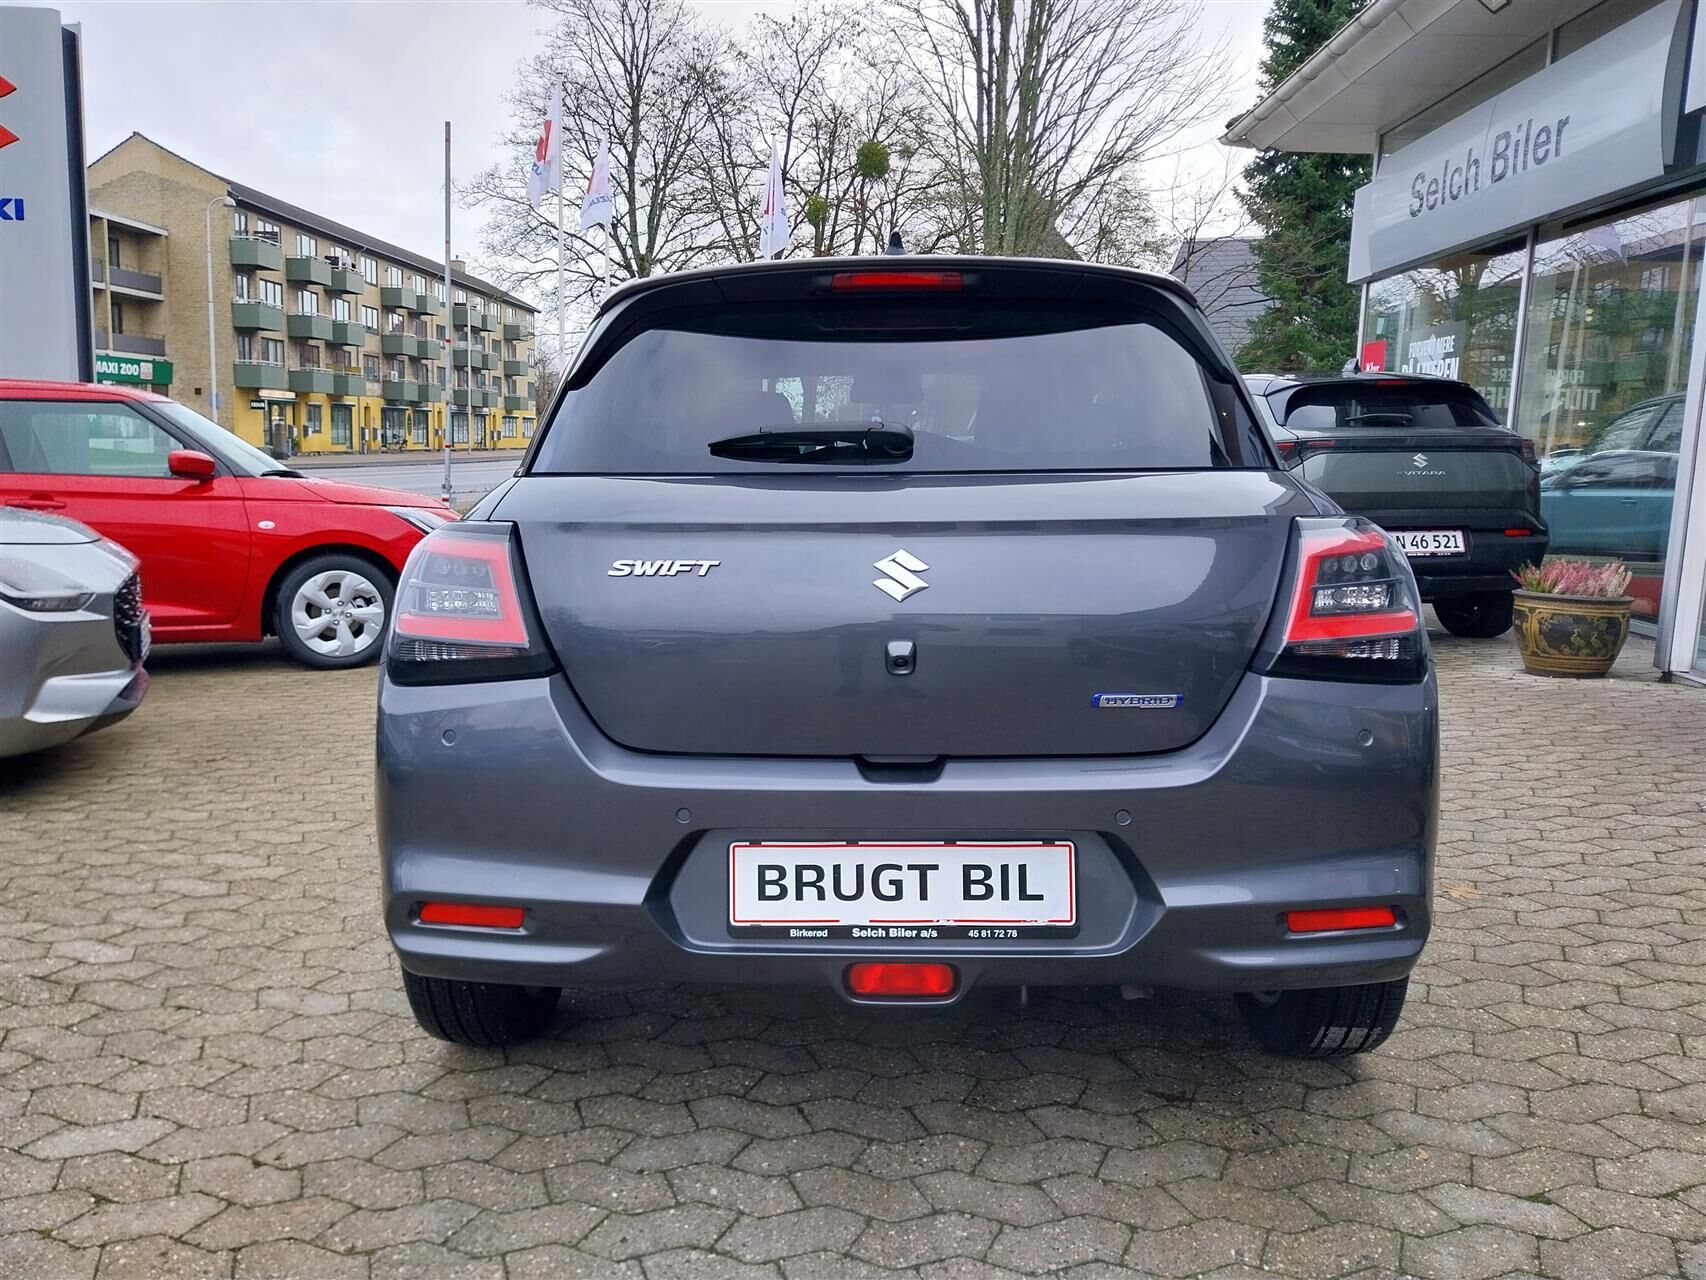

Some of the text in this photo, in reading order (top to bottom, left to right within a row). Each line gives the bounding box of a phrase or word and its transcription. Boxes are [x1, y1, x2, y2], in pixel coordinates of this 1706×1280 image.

[1409, 115, 1570, 218] Selch Biler
[120, 363, 140, 376] ZOO
[1410, 534, 1429, 549] 46
[1433, 534, 1460, 549] 521
[607, 559, 721, 578] SWIFT
[1103, 696, 1174, 706] HYBRID
[757, 863, 1045, 902] BRUGT BIL
[789, 927, 1018, 939] Birkerød Selch Biler a/s 45 81 72 78
